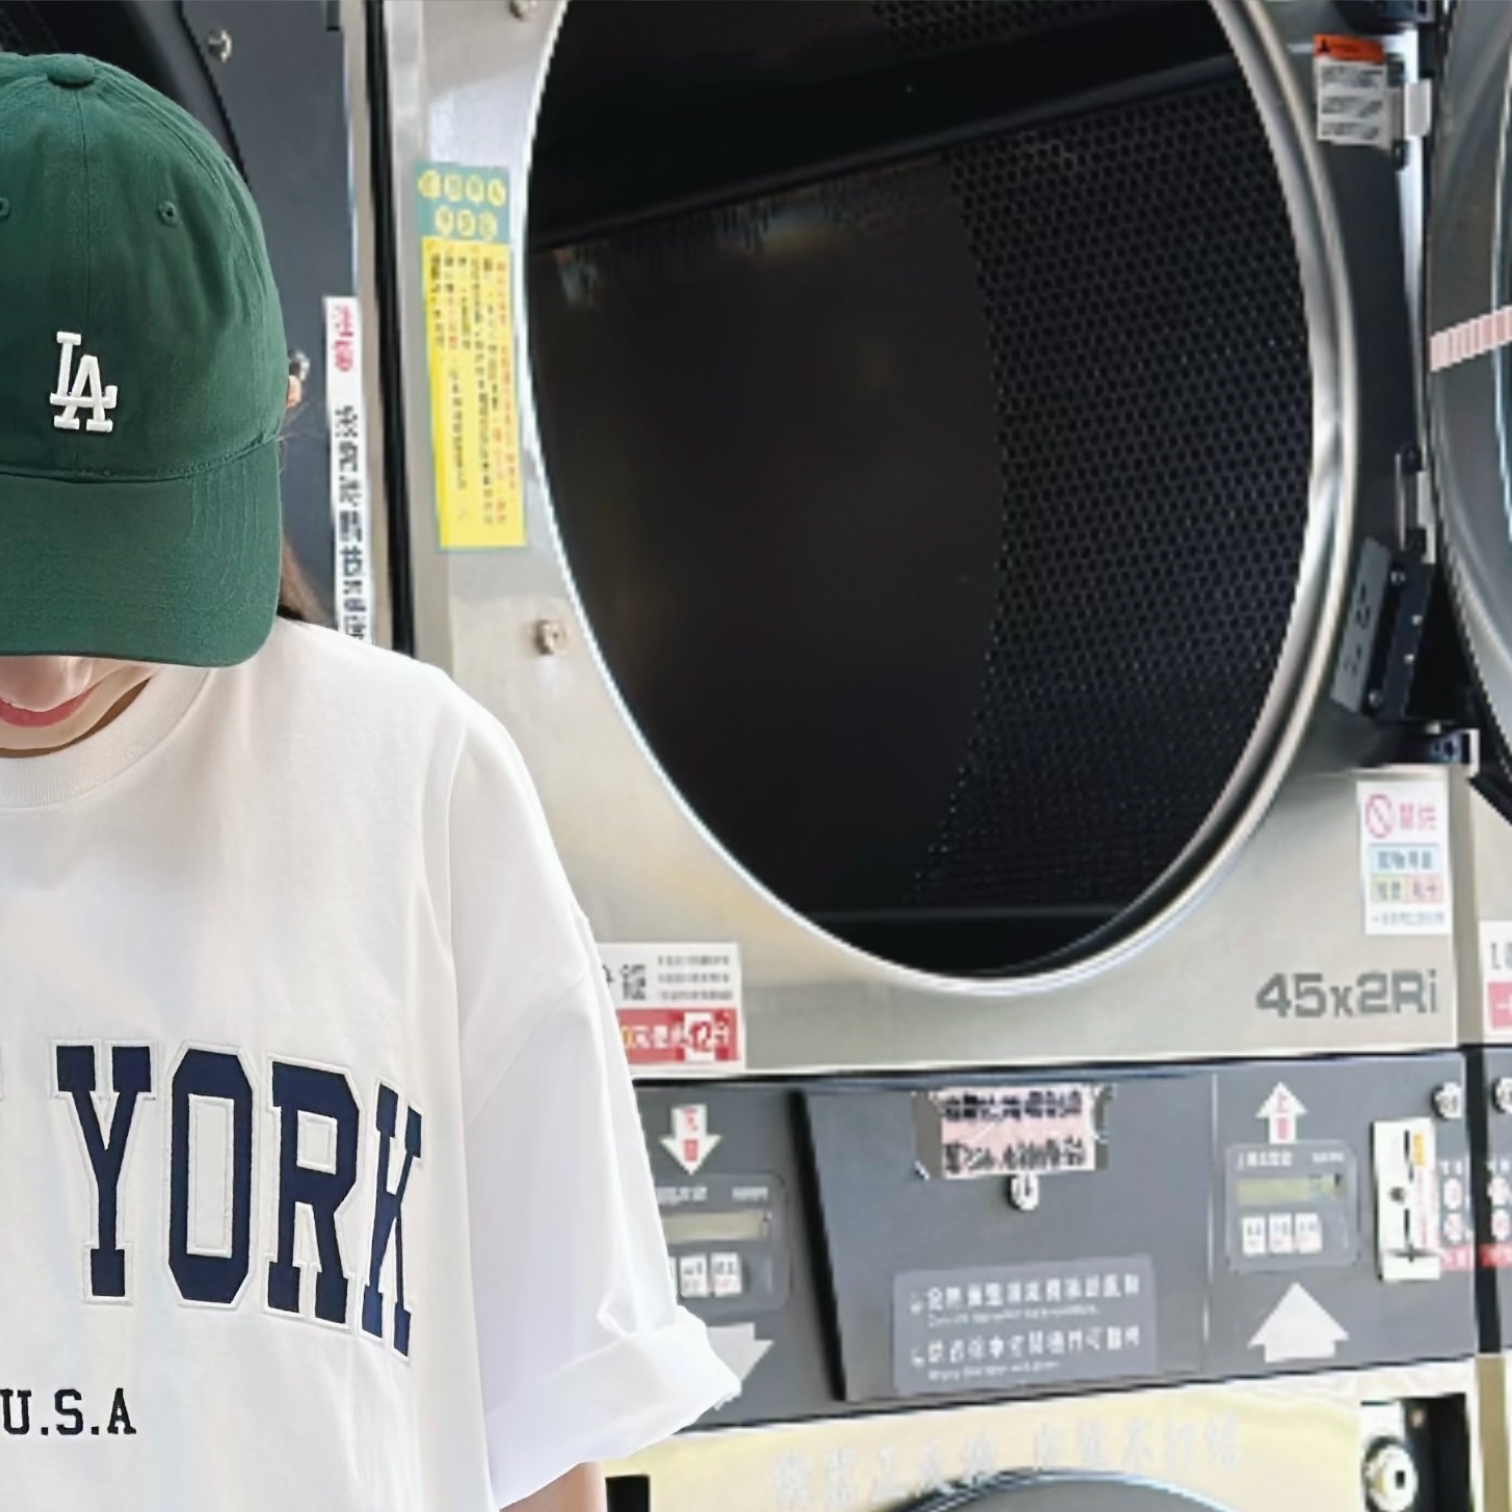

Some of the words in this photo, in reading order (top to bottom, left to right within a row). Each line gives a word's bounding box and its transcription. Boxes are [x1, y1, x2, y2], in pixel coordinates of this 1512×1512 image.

[49, 331, 118, 433] LA
[1256, 969, 1437, 1018] 45x2Ri
[52, 1042, 425, 1358] YORK
[0, 1387, 136, 1436] U.S.A
